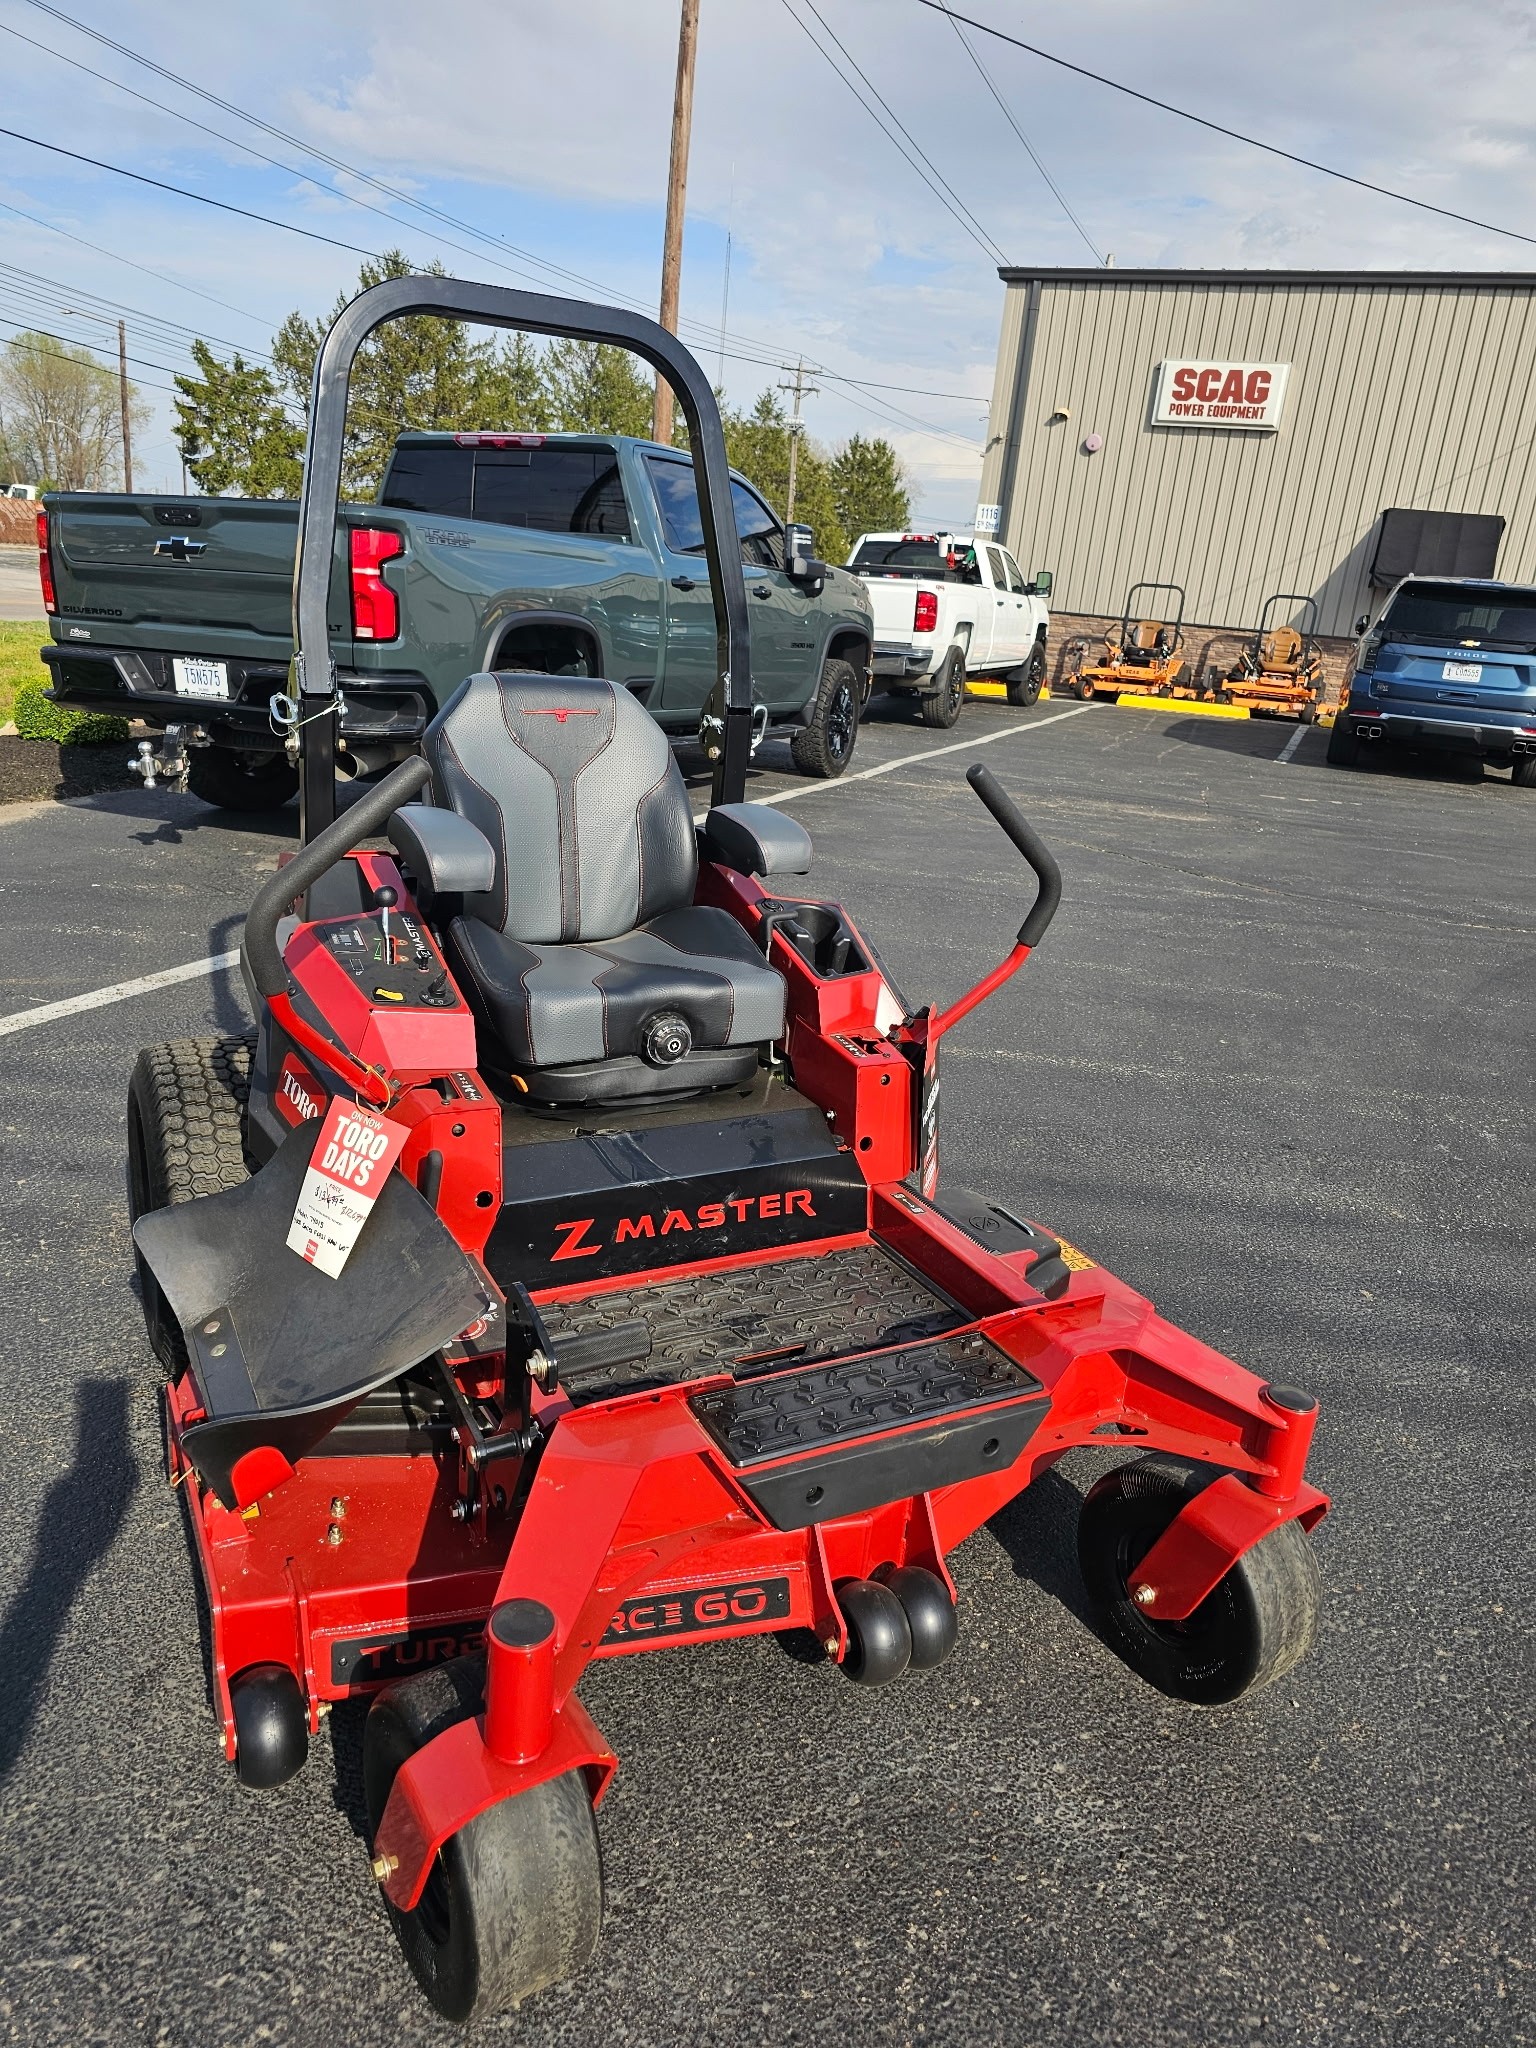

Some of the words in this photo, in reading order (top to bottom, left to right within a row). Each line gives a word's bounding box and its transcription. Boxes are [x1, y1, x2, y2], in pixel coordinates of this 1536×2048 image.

[1172, 368, 1272, 404] SCAG
[1169, 403, 1205, 417] POWER
[1207, 404, 1267, 420] EQUIPMENT
[981, 508, 999, 520] 1116
[62, 605, 123, 617] SILVERADO
[1446, 651, 1489, 659] TAHOE
[184, 667, 221, 687] T5N575
[402, 916, 428, 953] MASTER
[283, 1069, 318, 1120] TORO
[333, 1115, 389, 1160] TORO
[351, 1110, 363, 1122] ON
[363, 1116, 384, 1131] NOW
[321, 1141, 375, 1187] DAYS
[551, 1218, 603, 1262] Z
[615, 1188, 817, 1243] MASTER
[360, 1631, 486, 1670] TURB
[602, 1604, 683, 1638] RCE
[694, 1587, 767, 1624] 60
